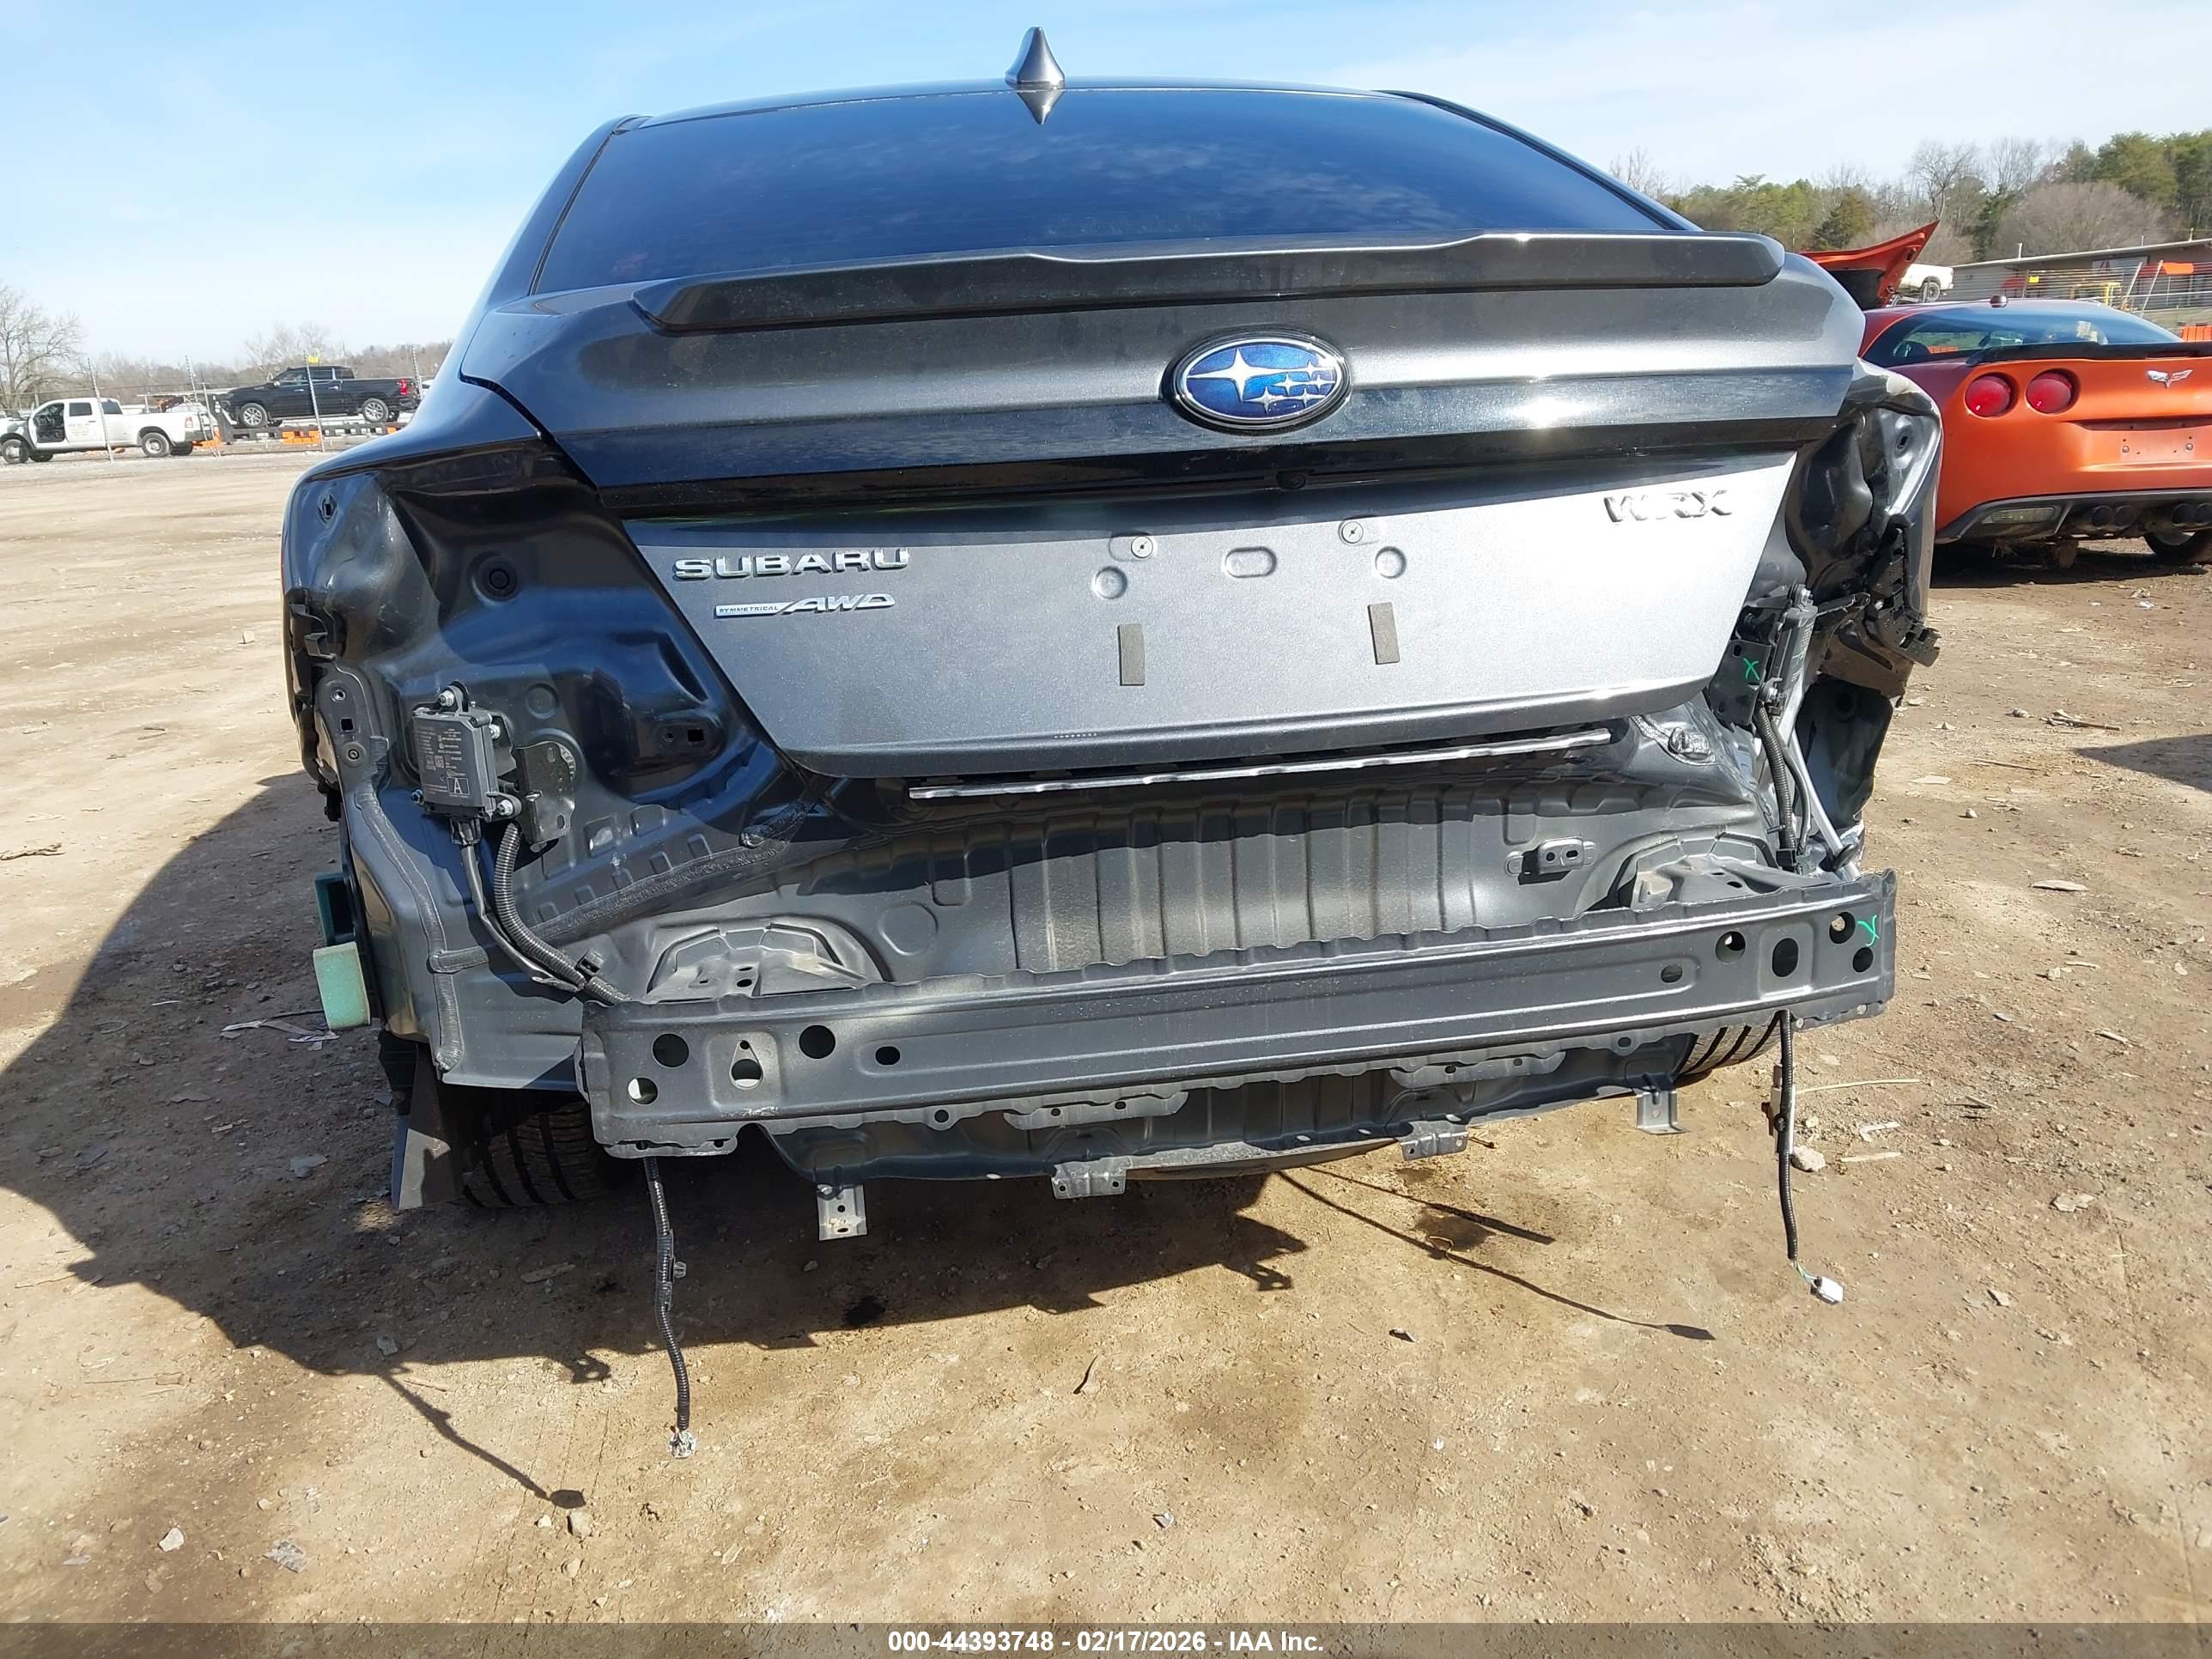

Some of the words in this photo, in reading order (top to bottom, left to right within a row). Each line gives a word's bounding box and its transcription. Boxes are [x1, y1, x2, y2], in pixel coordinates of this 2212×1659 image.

[1603, 489, 1732, 523] WRX
[674, 547, 909, 580] SUBARU
[719, 605, 779, 614] SYMMETRICAL
[780, 593, 896, 616] AWD
